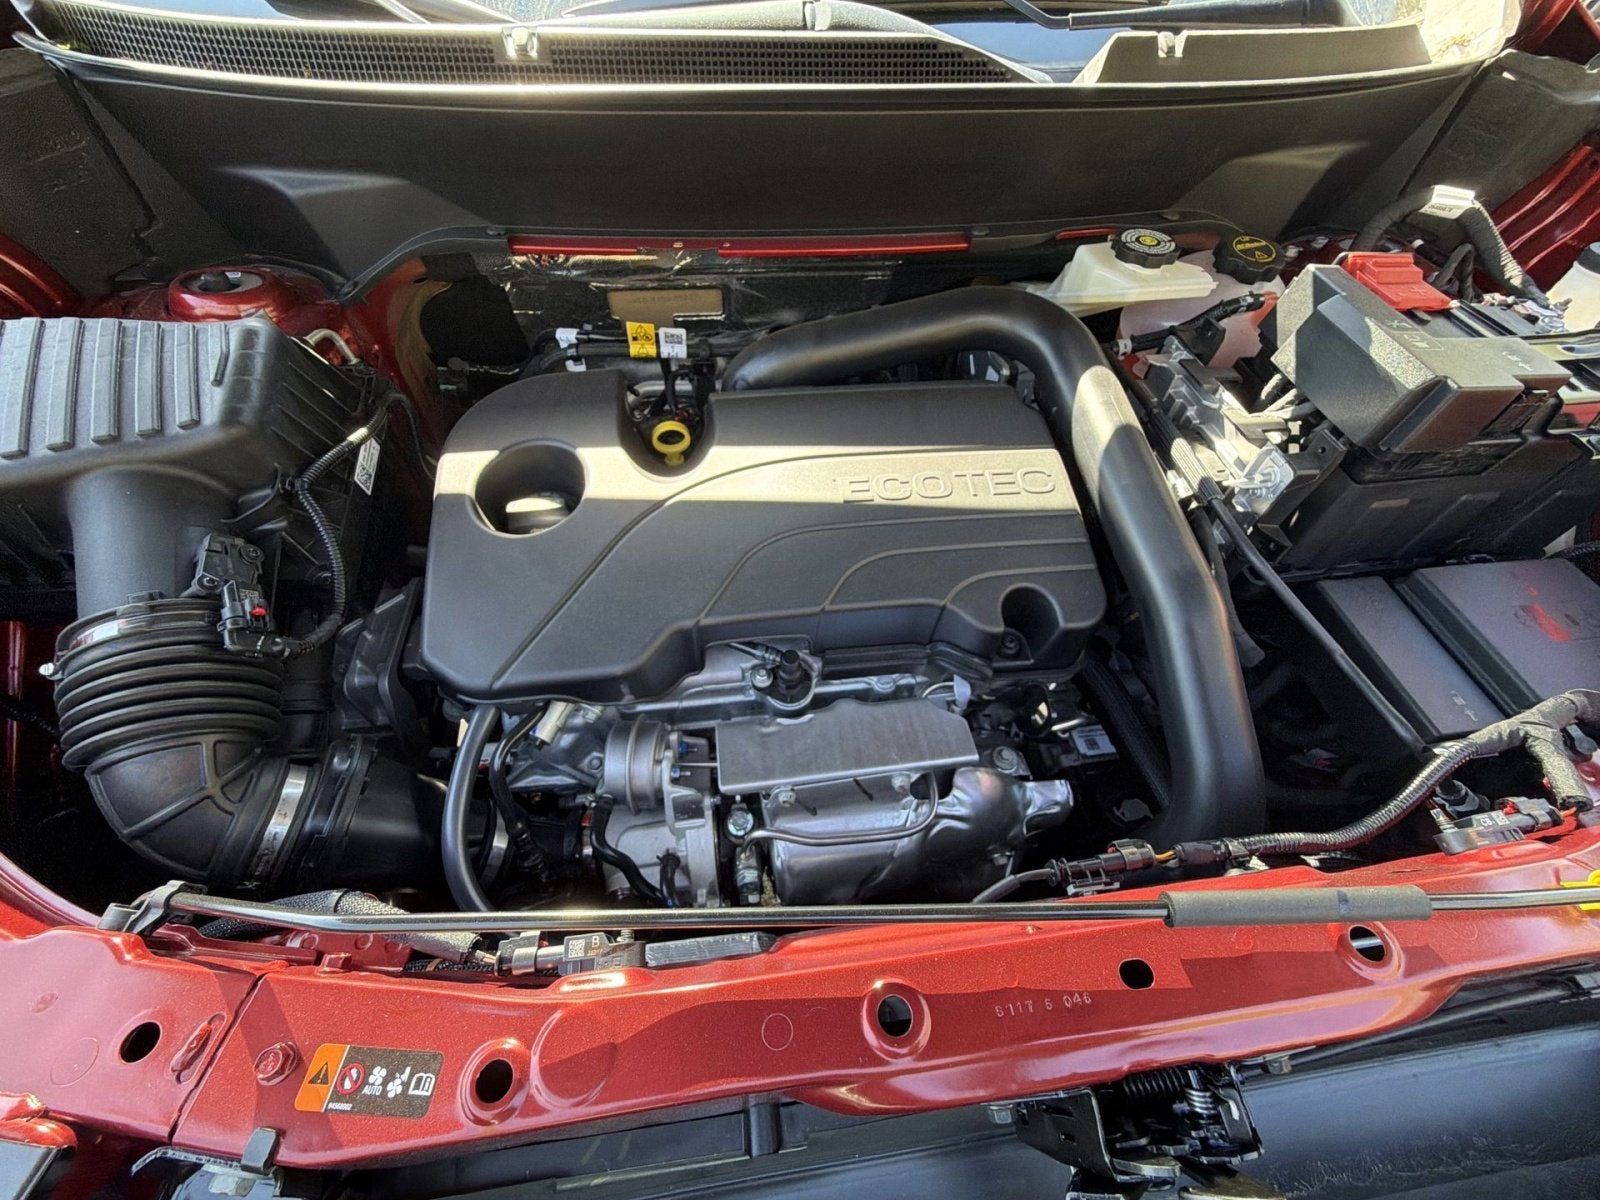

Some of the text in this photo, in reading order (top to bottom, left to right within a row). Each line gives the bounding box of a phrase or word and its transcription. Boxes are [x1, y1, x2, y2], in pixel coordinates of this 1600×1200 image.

[835, 467, 1056, 503] ECOTEC
[591, 936, 600, 948] B
[361, 1085, 383, 1096] AUTO
